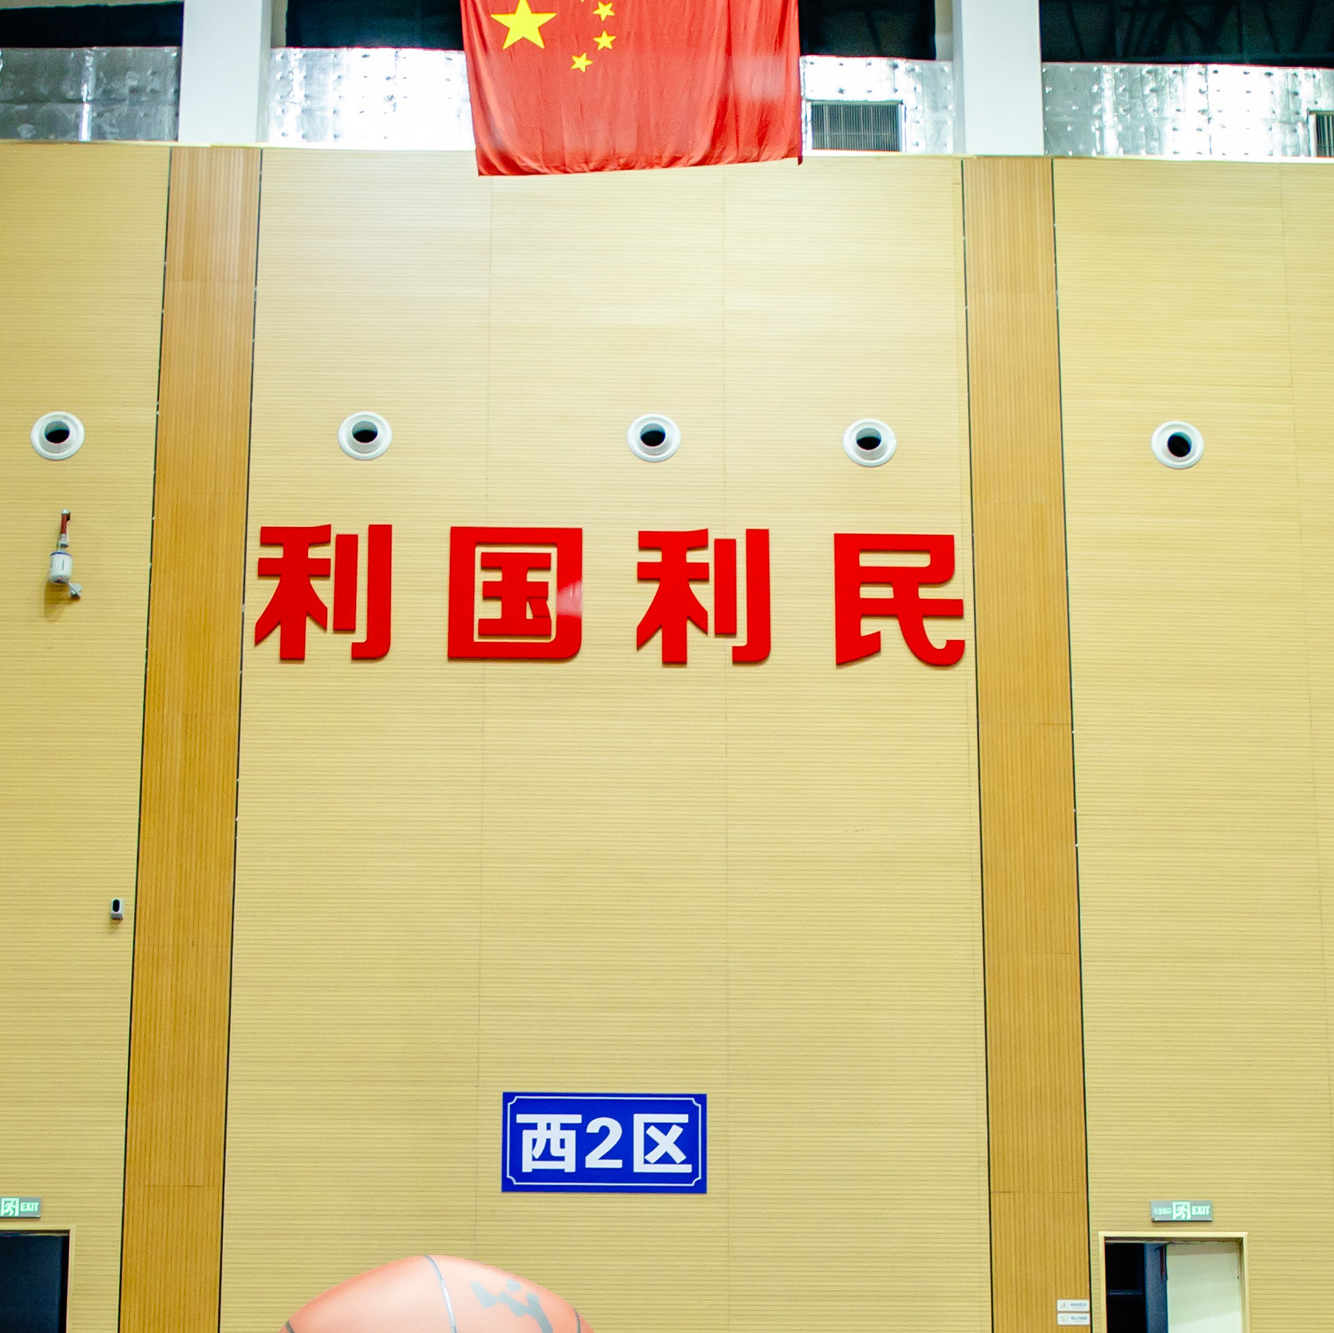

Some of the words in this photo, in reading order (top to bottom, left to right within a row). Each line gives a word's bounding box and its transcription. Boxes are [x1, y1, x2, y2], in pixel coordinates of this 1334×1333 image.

[255, 524, 966, 667] 利国利民
[515, 1113, 693, 1173] 西2区
[20, 1202, 39, 1212] EXIT
[1191, 1206, 1210, 1215] EXIT
